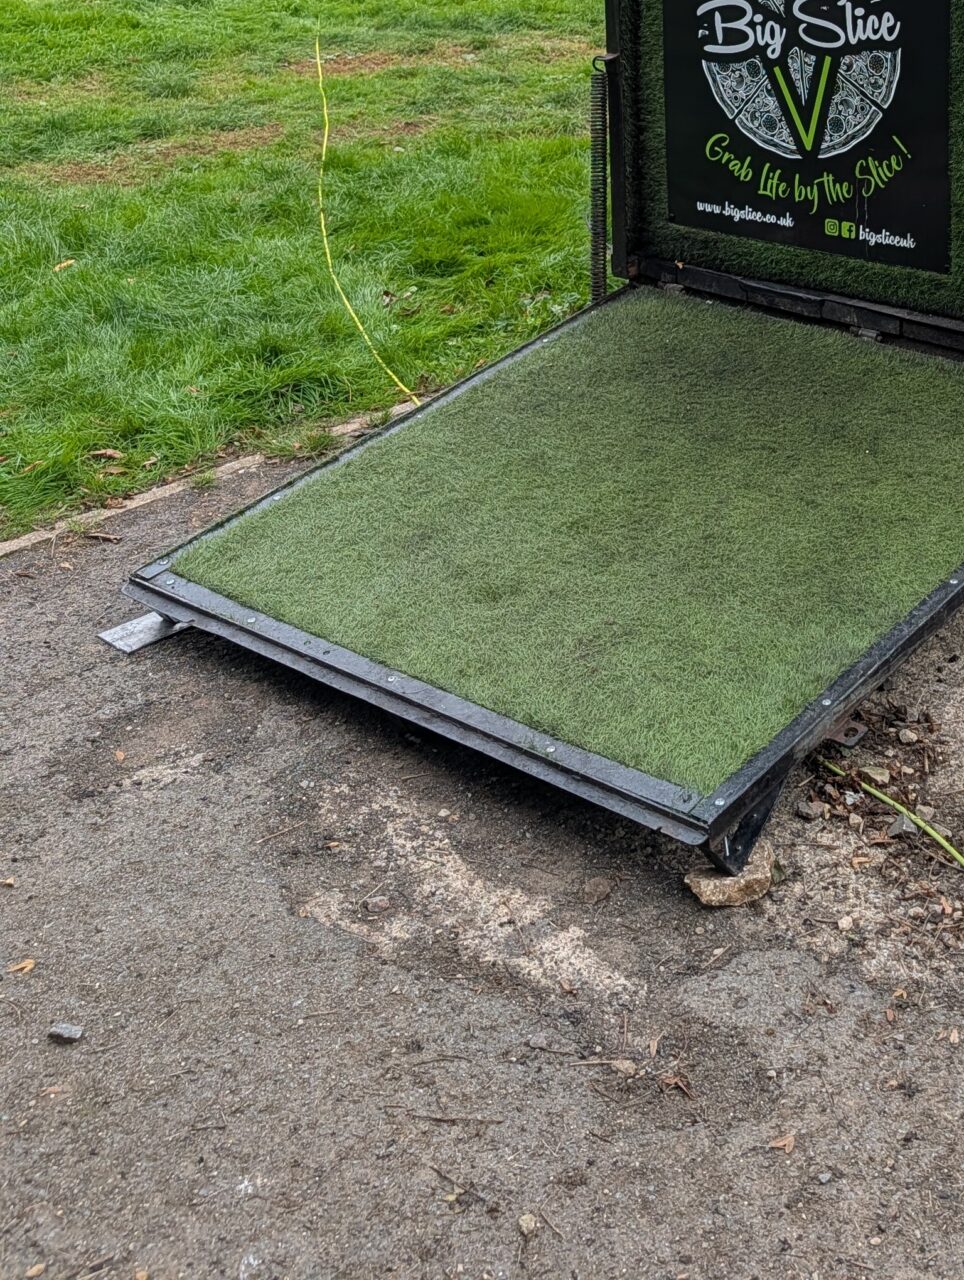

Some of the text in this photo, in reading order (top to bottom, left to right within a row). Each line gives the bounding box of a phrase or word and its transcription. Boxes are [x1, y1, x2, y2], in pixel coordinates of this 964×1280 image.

[705, 133, 912, 215] Grab Life by the Slice!
[858, 224, 917, 250] bigsliceuk
